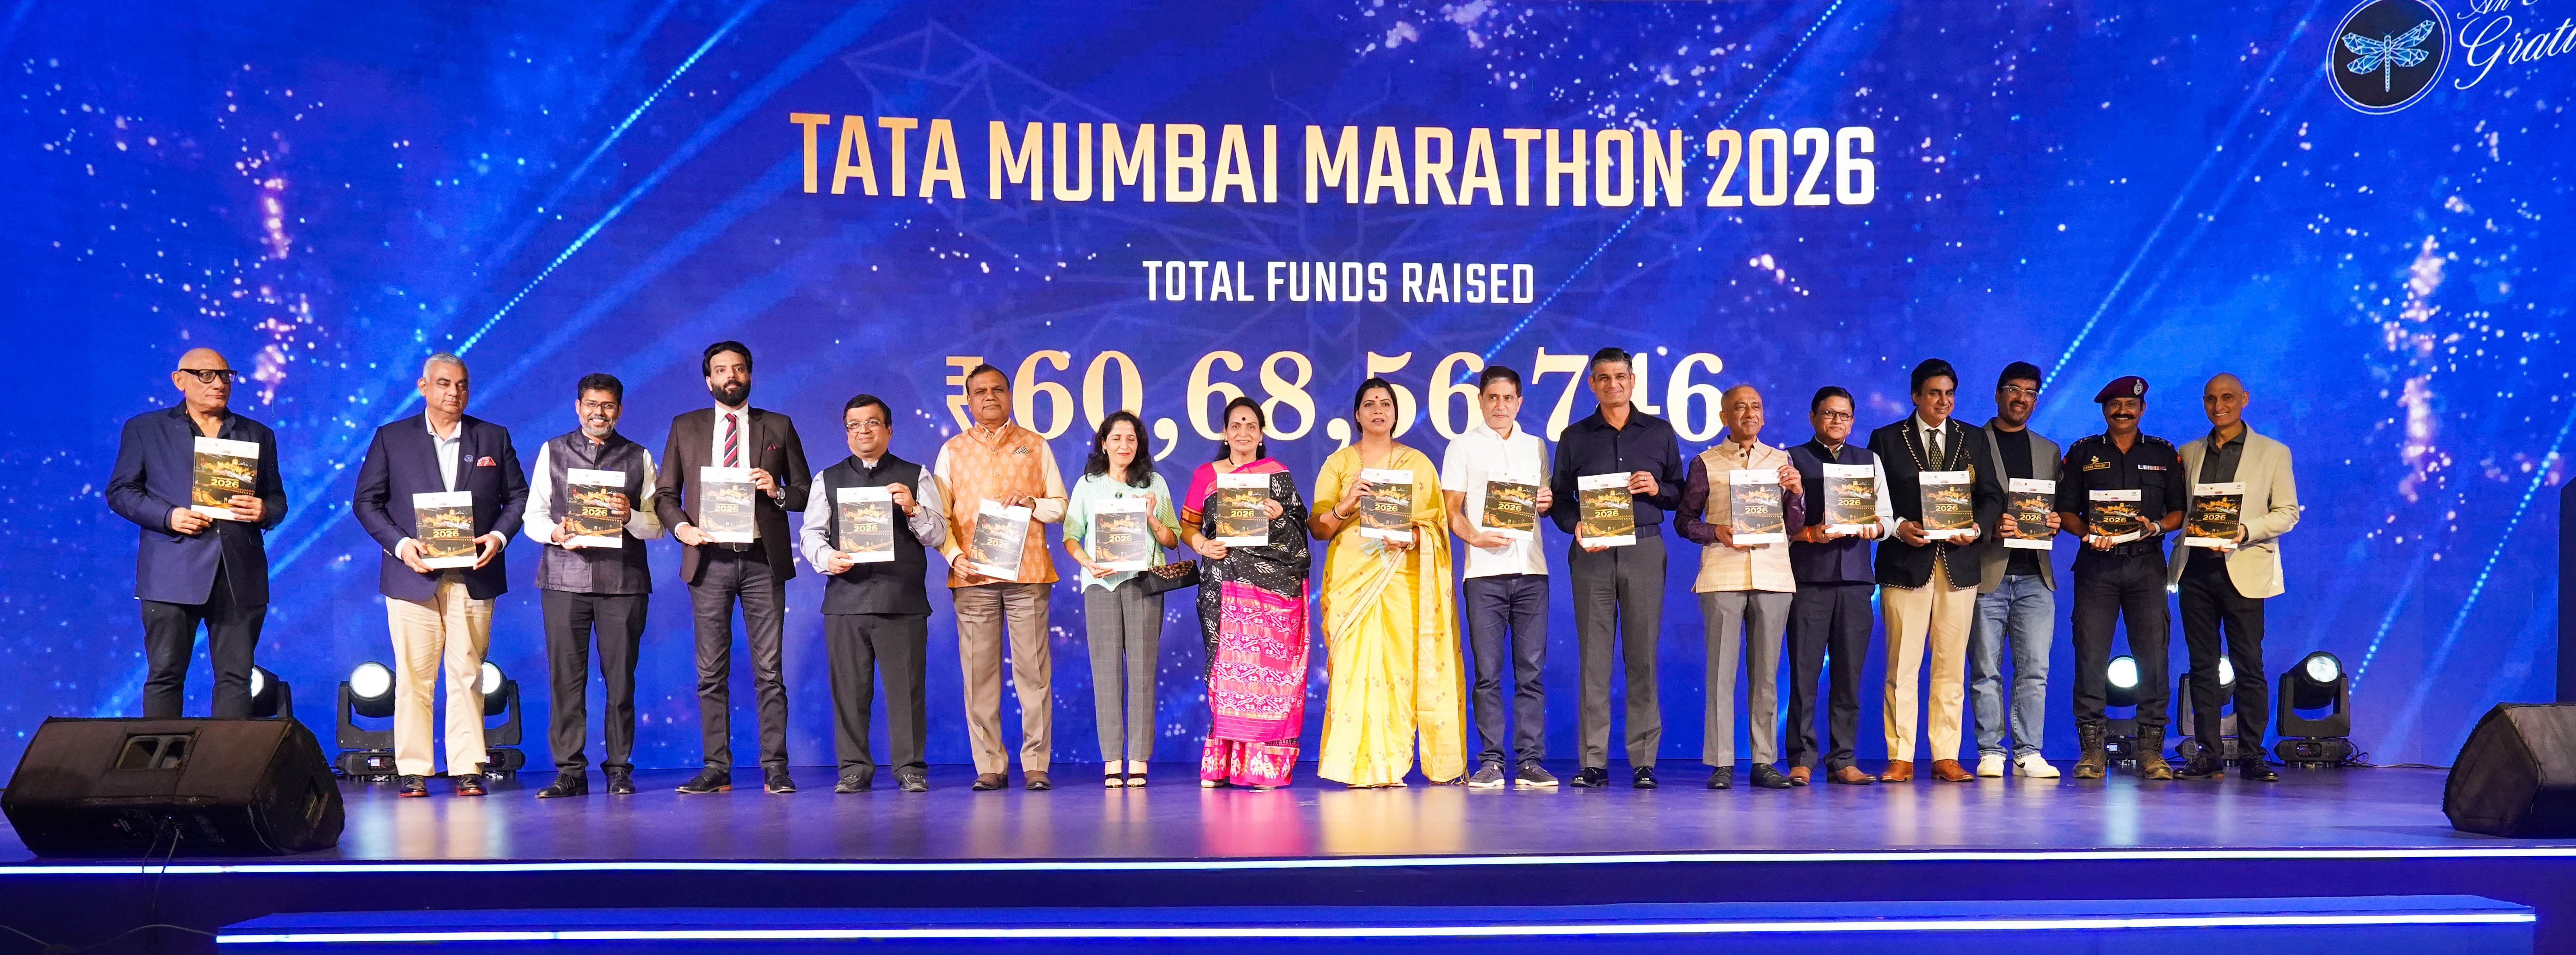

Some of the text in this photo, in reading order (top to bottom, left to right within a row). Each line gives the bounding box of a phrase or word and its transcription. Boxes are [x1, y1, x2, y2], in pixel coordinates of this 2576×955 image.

[790, 113, 1874, 207] TATA MUMBAI MARATHON 2026
[1142, 261, 1534, 304] TOTAL FUNDS RAISED
[210, 478, 239, 488] 2026
[987, 539, 1009, 548] 2026
